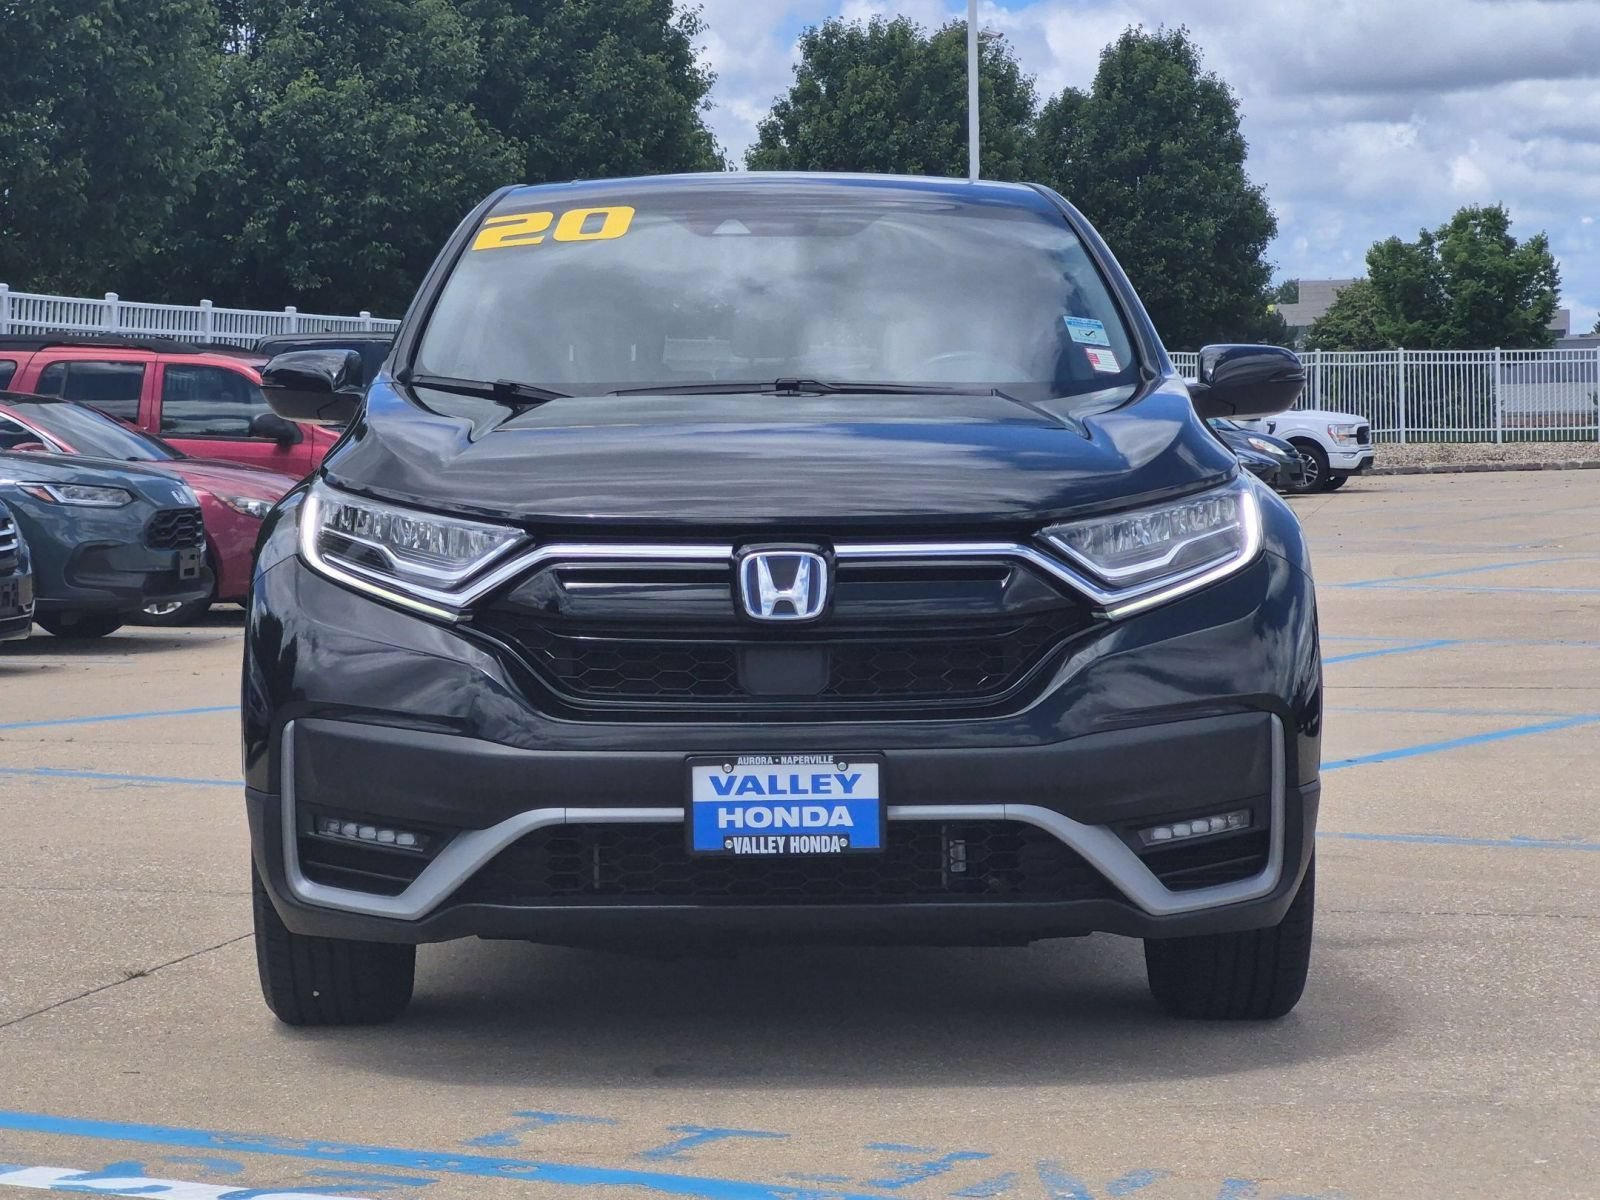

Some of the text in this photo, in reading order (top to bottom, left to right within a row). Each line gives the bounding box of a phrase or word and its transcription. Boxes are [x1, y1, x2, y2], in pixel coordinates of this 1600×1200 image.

[472, 206, 636, 250] 20
[737, 755, 834, 765] AURORA NAPERVILLE
[709, 773, 862, 796] VALLEY
[718, 805, 854, 828] HONDA
[733, 835, 841, 854] VALLEY HONDA
